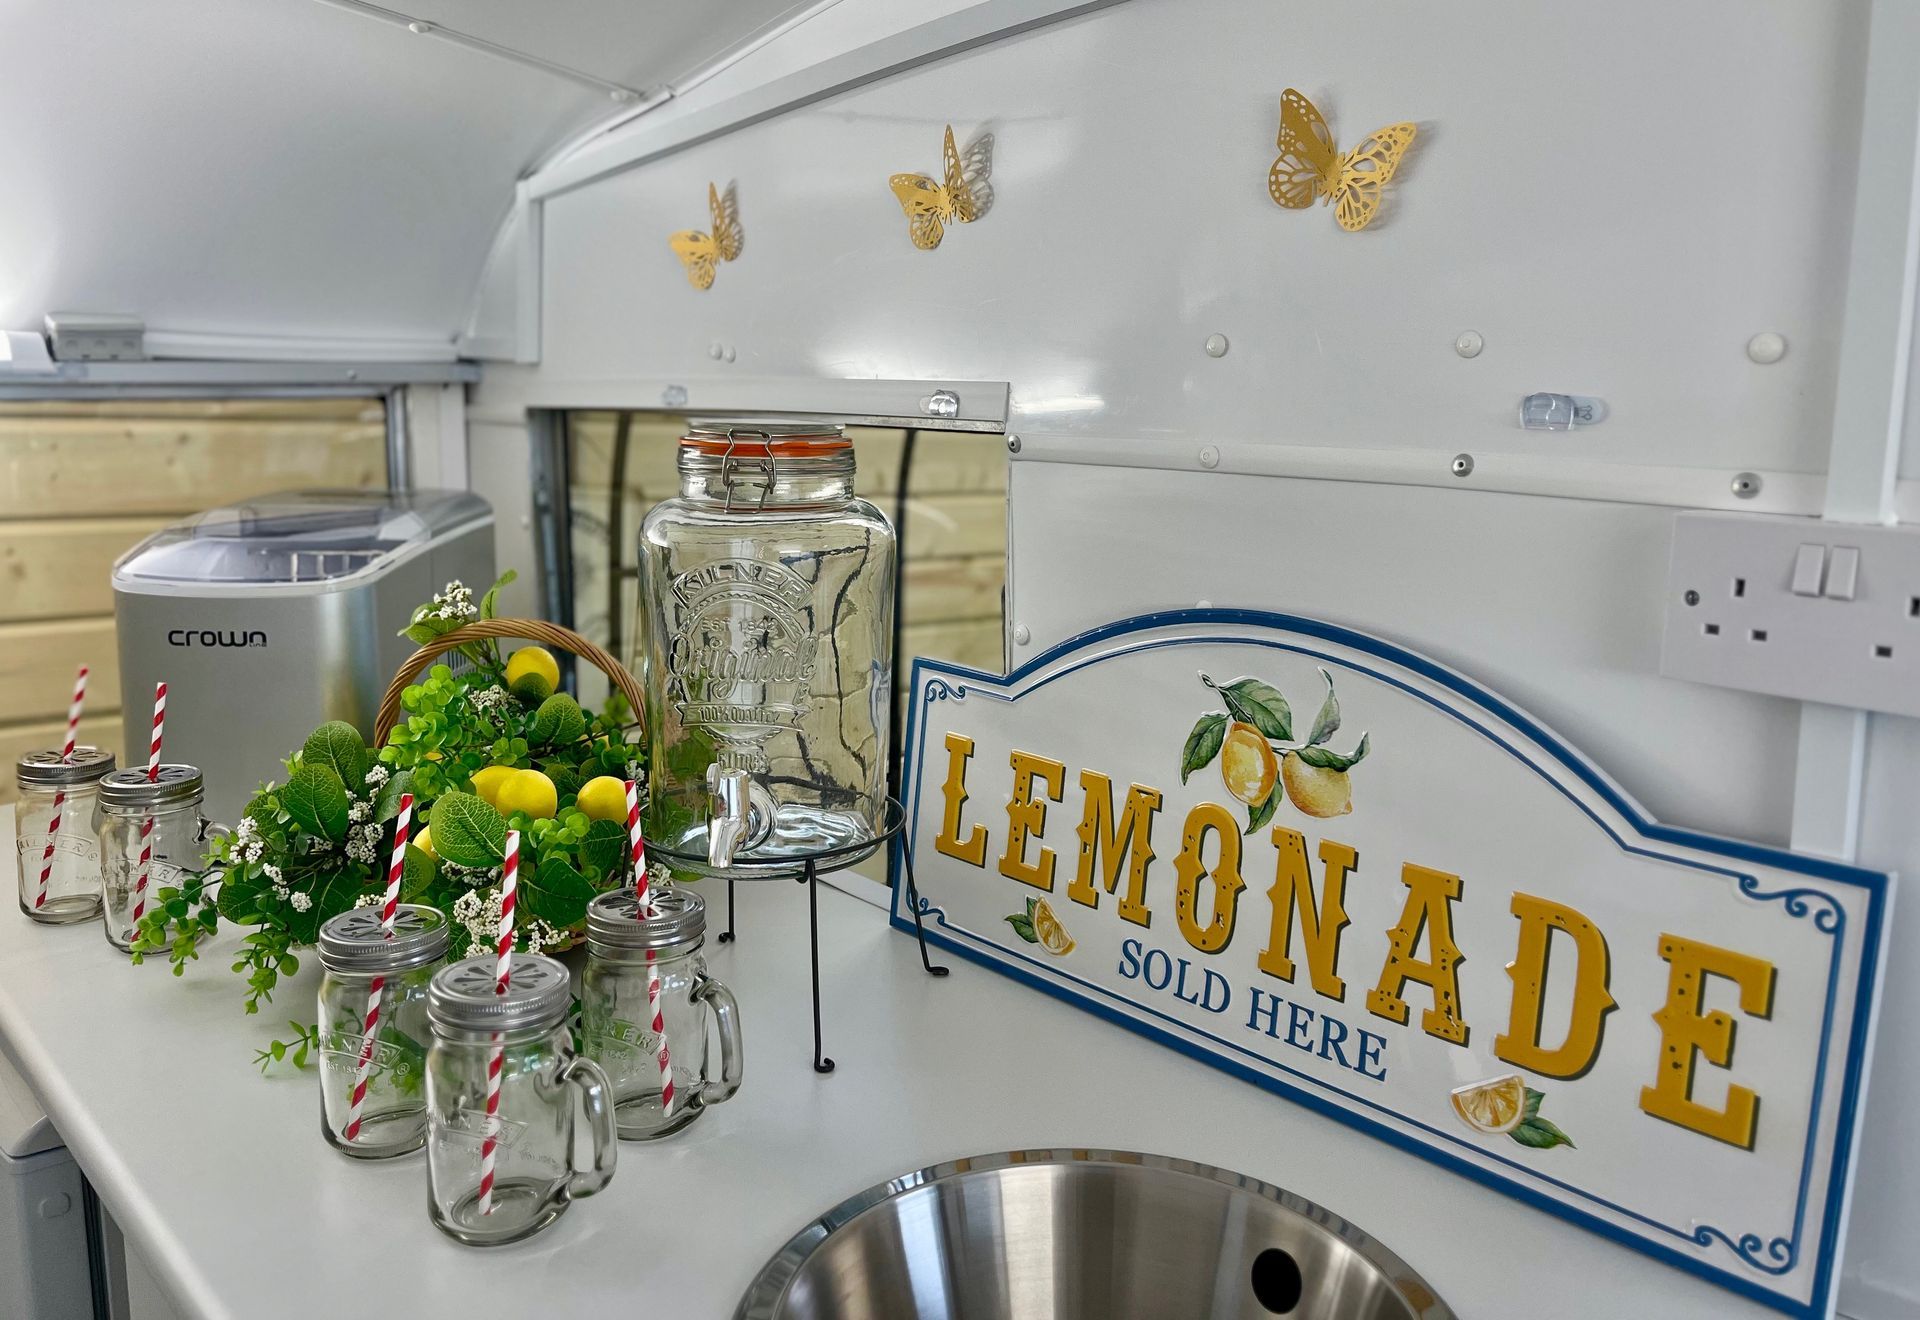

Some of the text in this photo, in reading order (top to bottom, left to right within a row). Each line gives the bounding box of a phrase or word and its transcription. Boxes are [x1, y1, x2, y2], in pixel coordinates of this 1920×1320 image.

[676, 563, 807, 604] KILNER
[168, 630, 267, 647] crown
[934, 730, 1777, 1152] LEMONADE
[1118, 938, 1389, 1083] SOLD HERE
